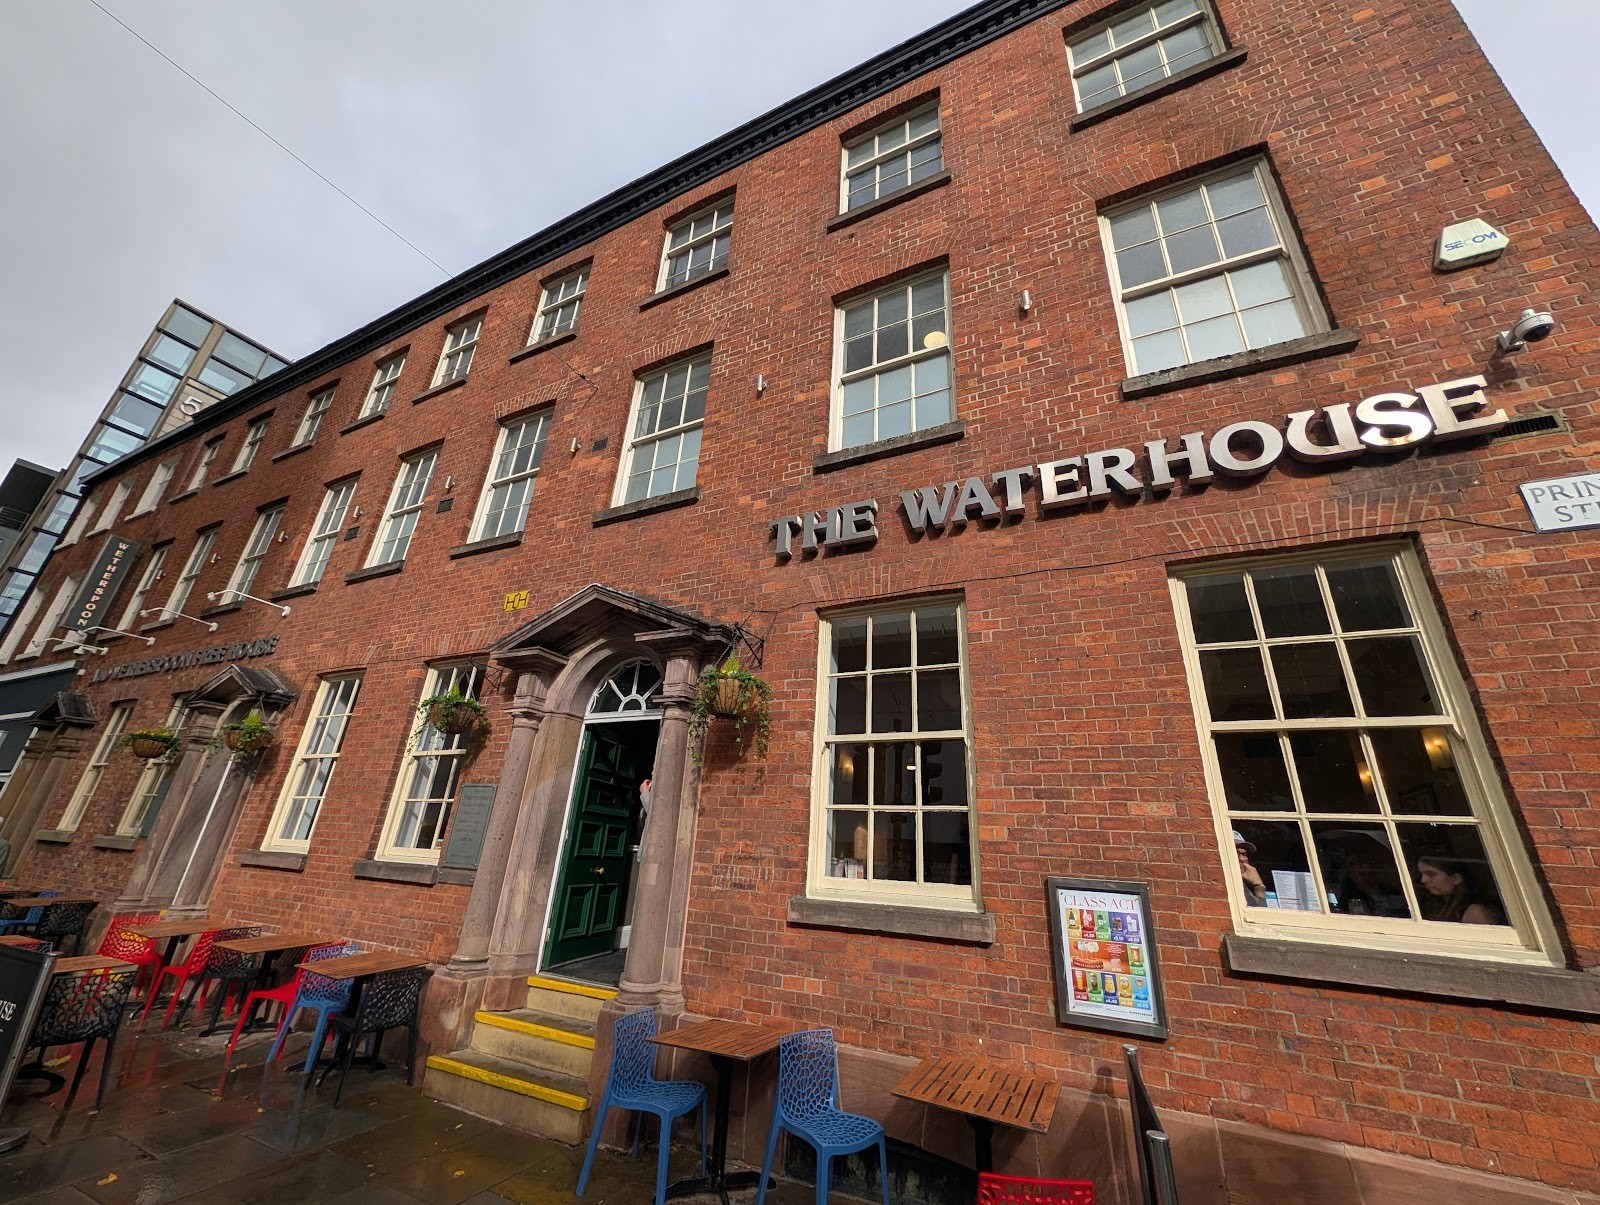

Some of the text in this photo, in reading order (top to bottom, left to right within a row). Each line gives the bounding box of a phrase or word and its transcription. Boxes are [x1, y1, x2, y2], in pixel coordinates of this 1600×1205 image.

[1444, 231, 1498, 251] SECOM
[180, 395, 203, 417] 5
[768, 374, 1509, 556] THE WATERHOUSE
[1554, 501, 1600, 523] ST
[77, 542, 130, 627] WETHERSPOON
[191, 644, 227, 665] FREE
[226, 636, 279, 661] HOUSE
[1064, 894, 1139, 911] CLASS ACT
